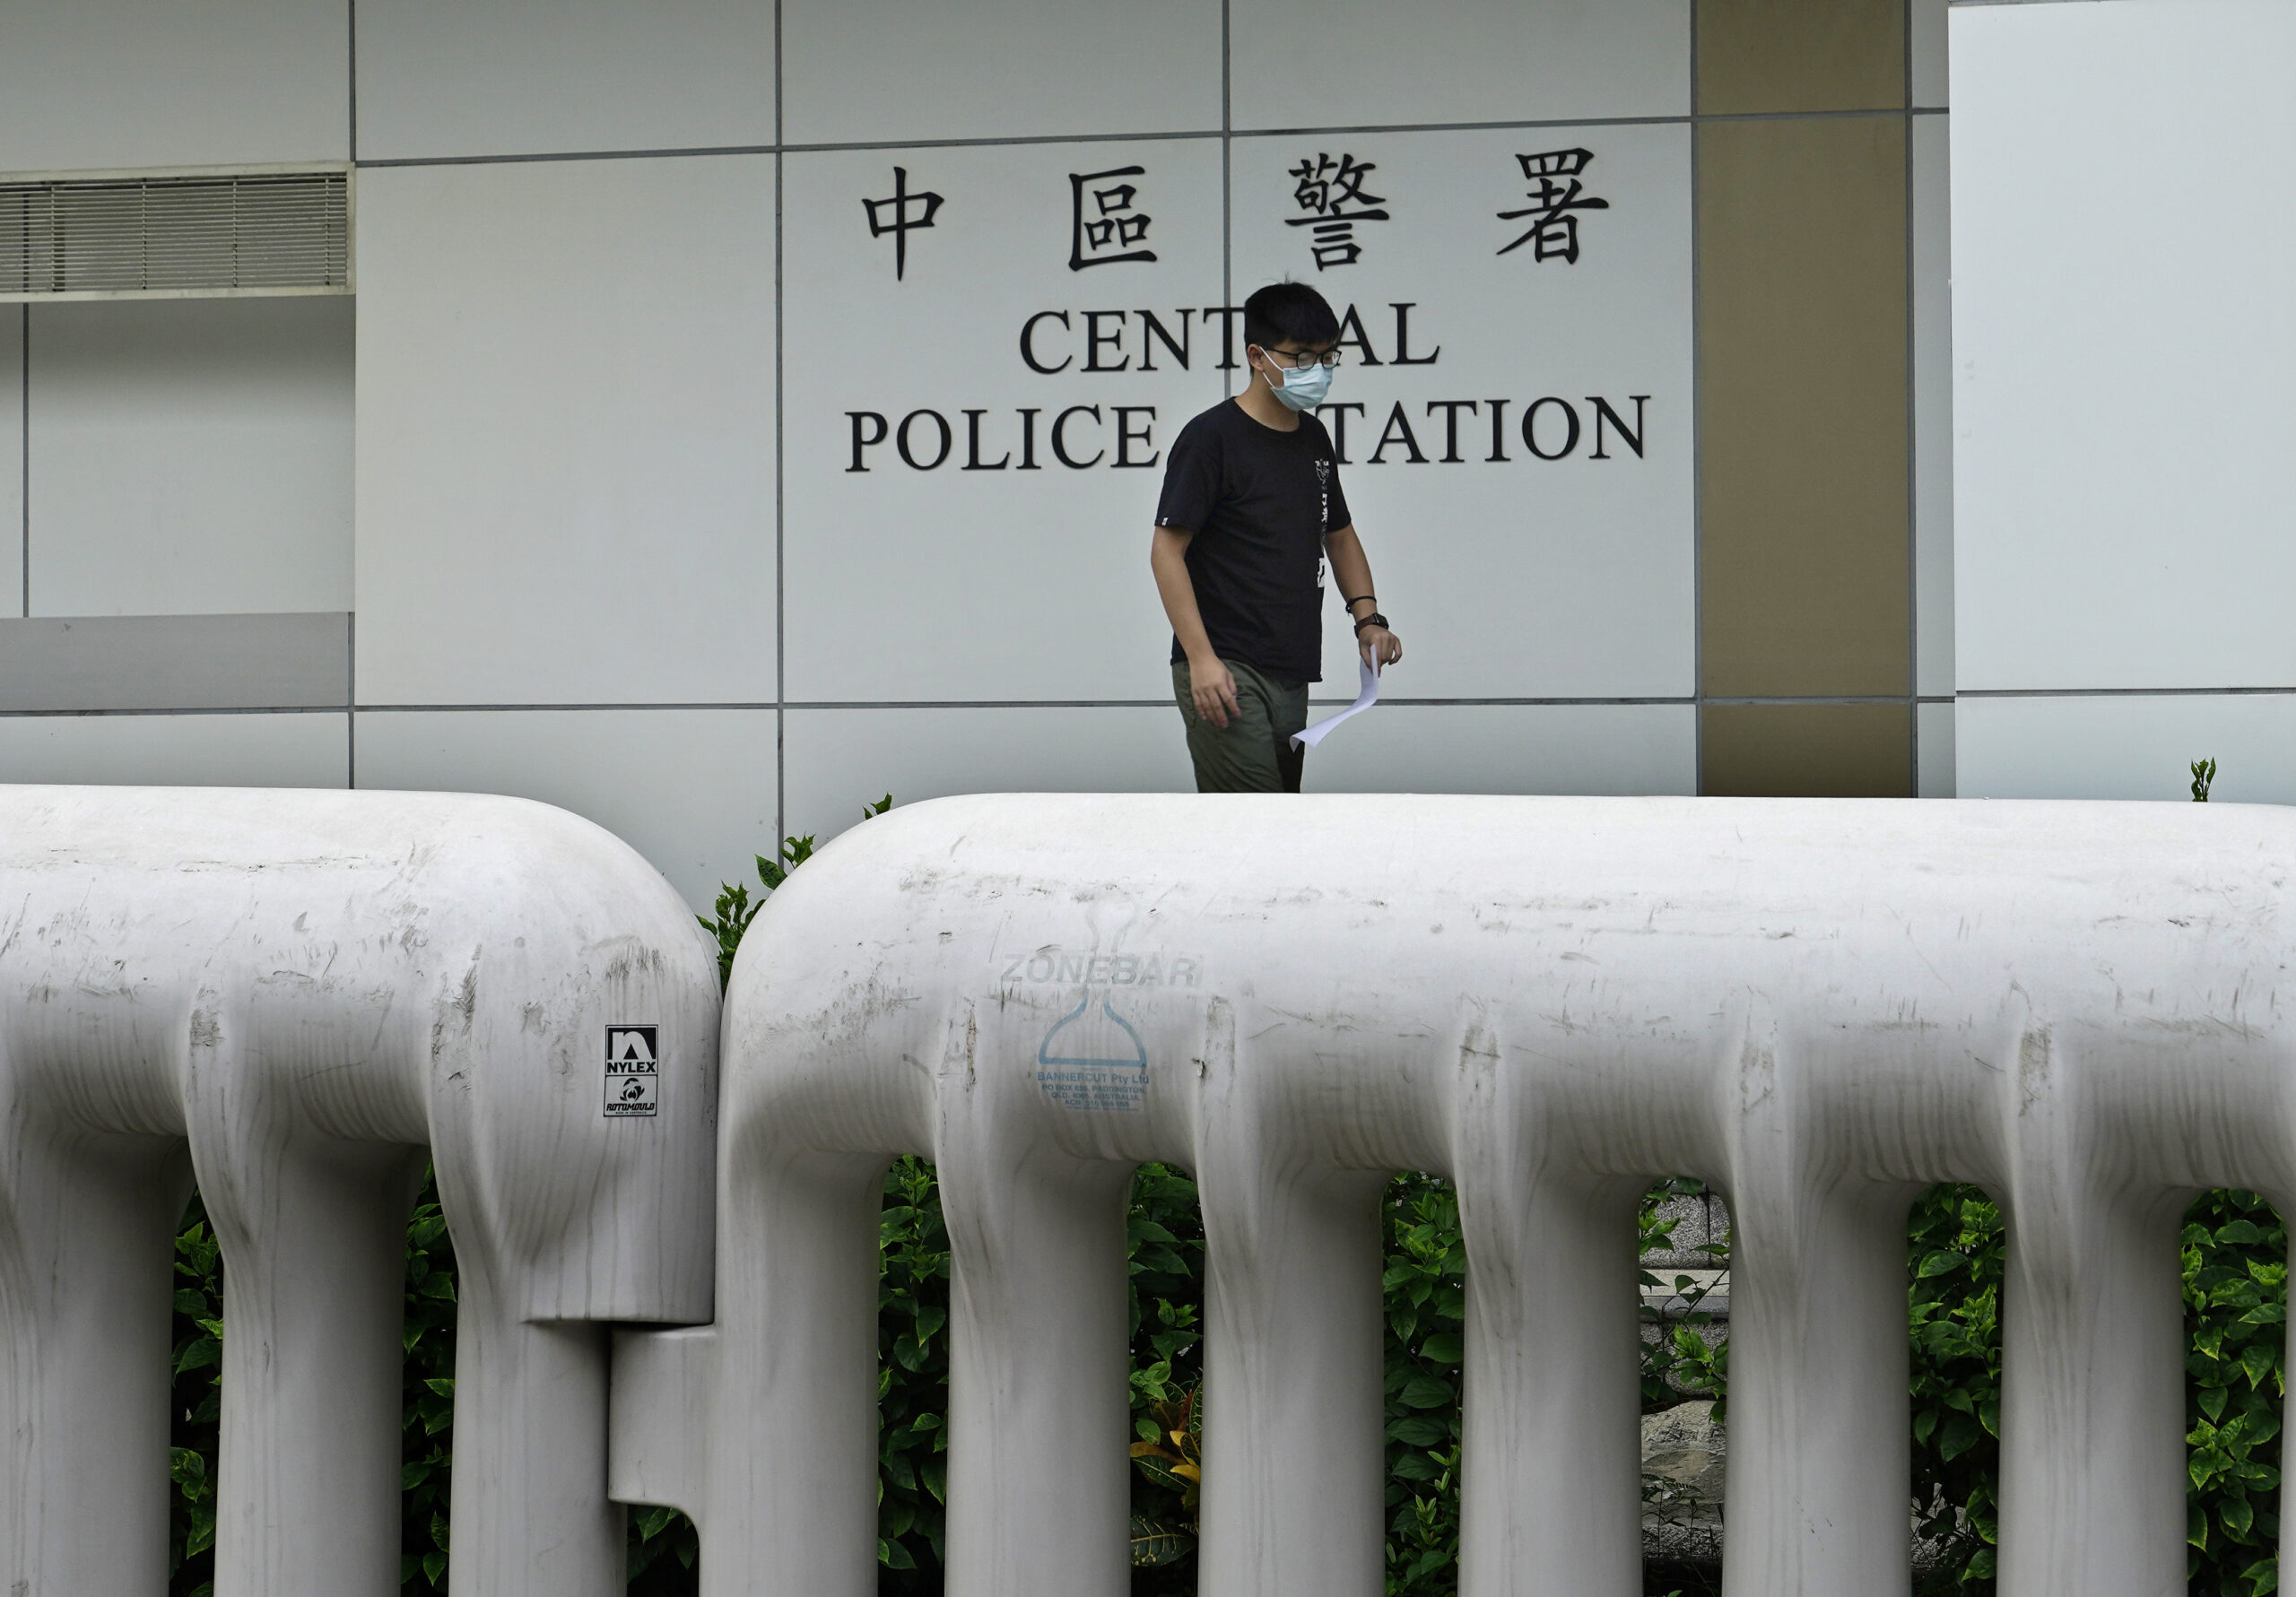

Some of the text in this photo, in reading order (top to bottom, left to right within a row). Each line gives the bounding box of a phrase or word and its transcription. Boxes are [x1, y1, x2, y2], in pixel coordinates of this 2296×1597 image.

[861, 147, 1610, 282] 中區警署
[1019, 302, 1440, 376] CENTAL
[844, 395, 1651, 473] POLICE TATION
[999, 952, 1198, 985] ZONEBAR
[606, 1061, 657, 1073] NYLEX
[1037, 1072, 1108, 1082] BANNERCUT
[1111, 1073, 1128, 1085] Pty
[605, 1102, 656, 1112] ROTOMOULD
